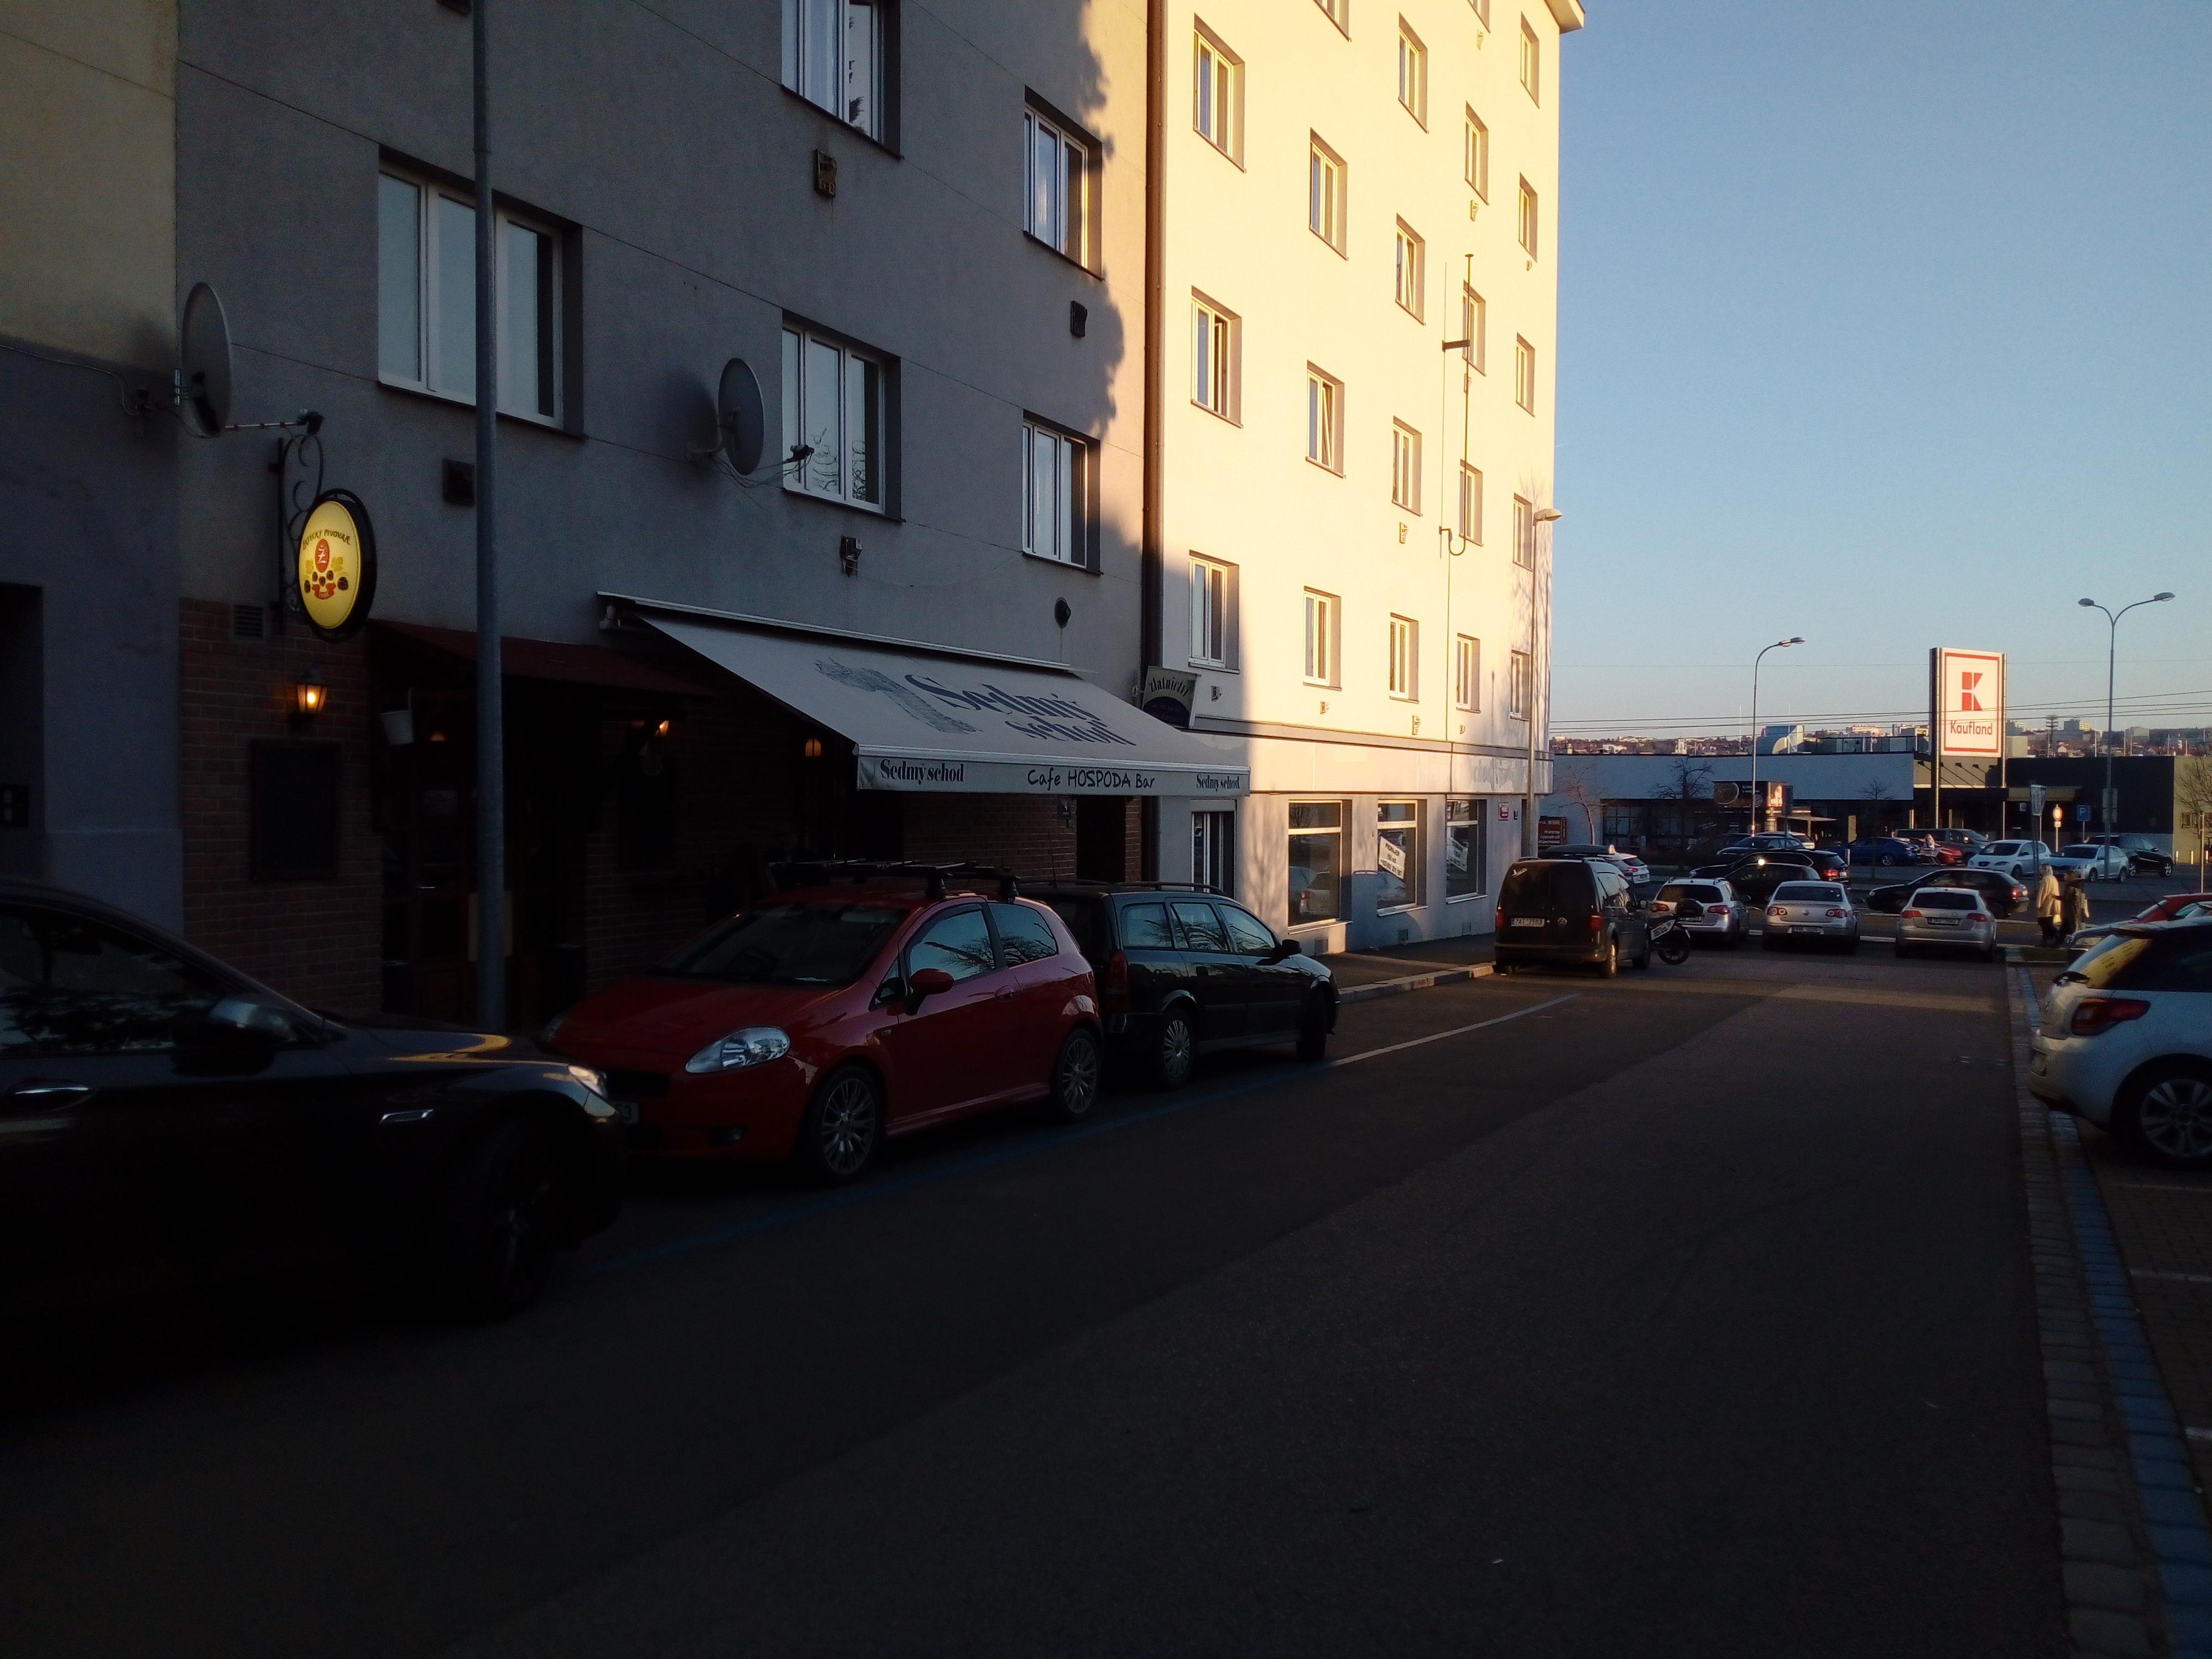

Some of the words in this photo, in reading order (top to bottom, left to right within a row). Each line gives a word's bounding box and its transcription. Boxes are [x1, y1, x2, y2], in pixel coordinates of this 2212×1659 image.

[324, 529, 351, 545] PIVOVAR
[1950, 720, 1992, 735] Kaufland
[927, 763, 964, 782] schod
[1027, 767, 1061, 791] Cafe
[1068, 769, 1130, 788] HOSPODA
[1135, 774, 1155, 789] Bar
